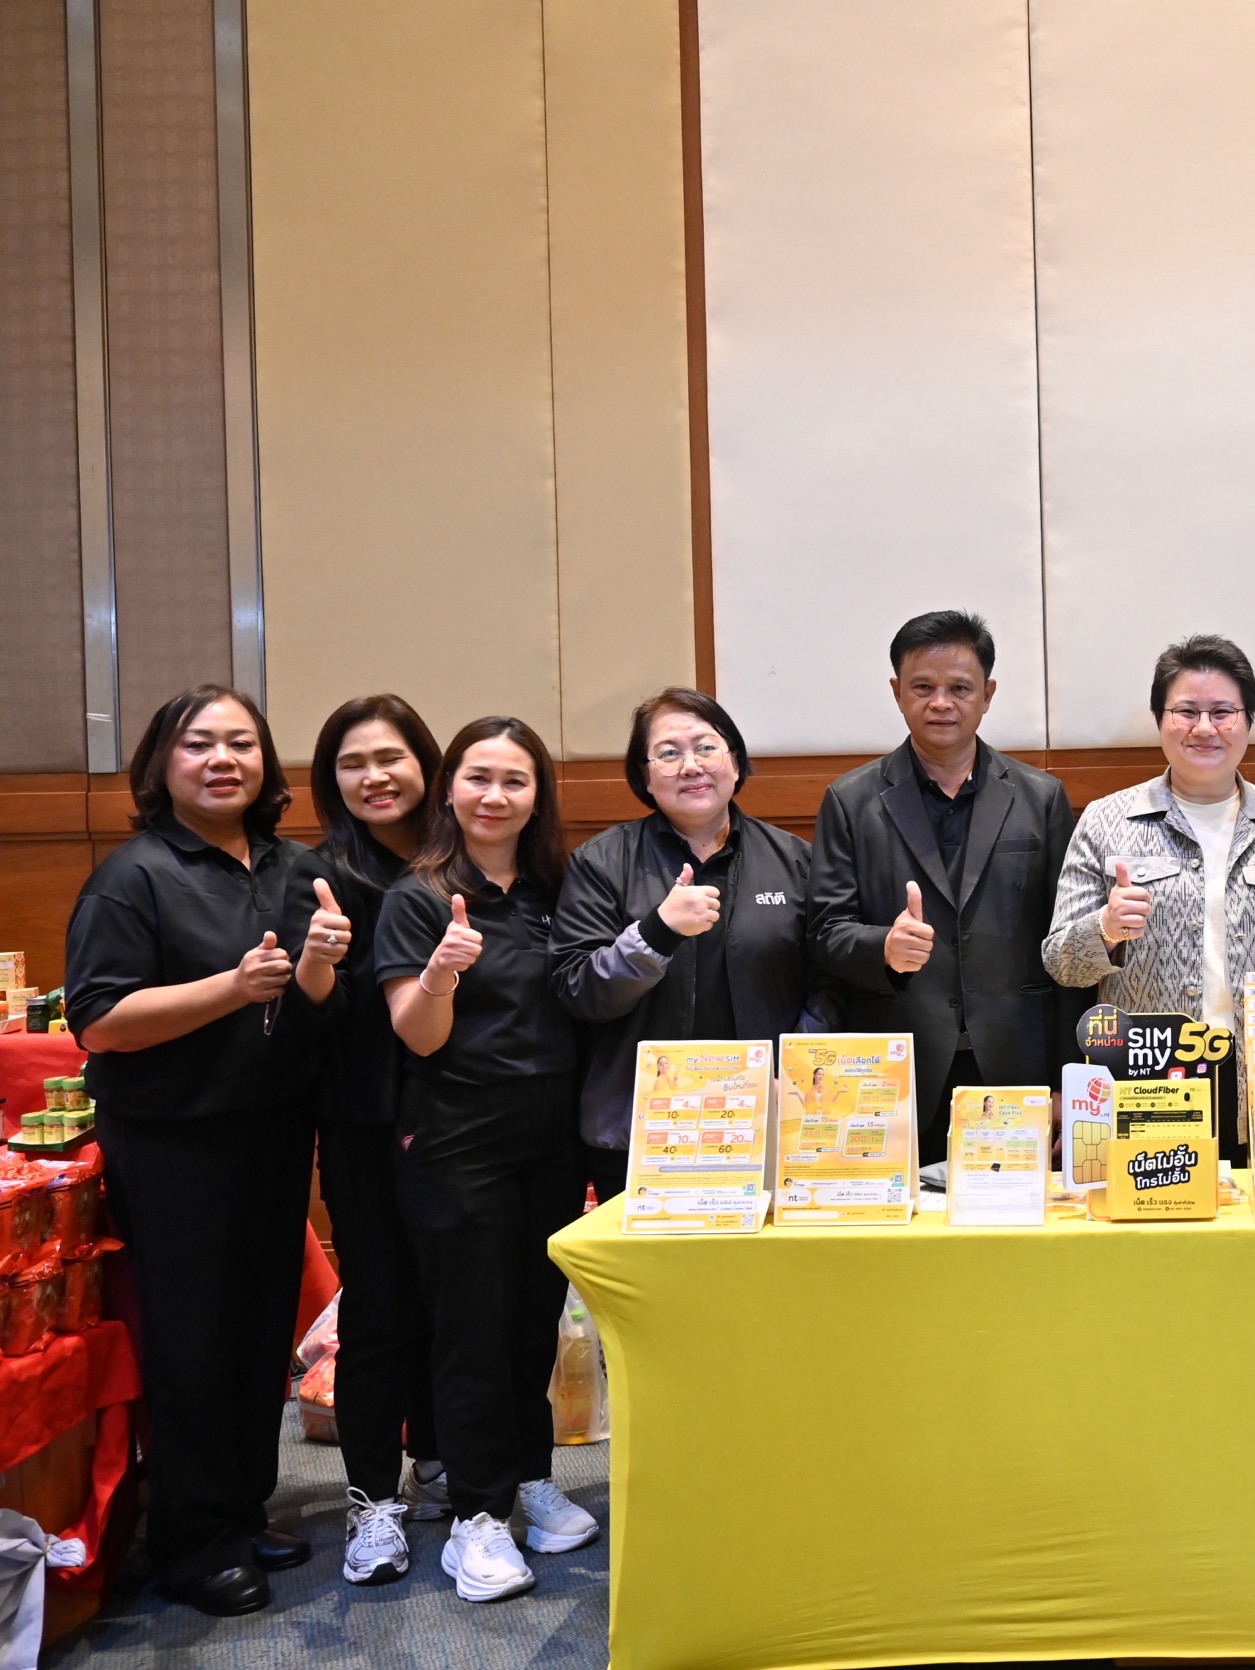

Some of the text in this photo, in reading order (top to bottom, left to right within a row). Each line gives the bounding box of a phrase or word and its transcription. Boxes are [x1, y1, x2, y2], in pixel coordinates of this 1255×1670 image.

[755, 891, 786, 905] สถิติ
[1088, 1008, 1118, 1036] ที่นี่
[1085, 1036, 1124, 1047] จำหน่าย
[1128, 1027, 1172, 1048] SIM
[1174, 1022, 1231, 1062] 5G
[686, 1056, 698, 1064] my
[1128, 1047, 1171, 1071] my
[1128, 1068, 1138, 1077] by
[1120, 1087, 1132, 1095] NT
[1072, 1099, 1101, 1116] my
[1128, 1145, 1196, 1174] เน็ตไม่อั้น
[1136, 1168, 1189, 1189] โทรไม่อั้น
